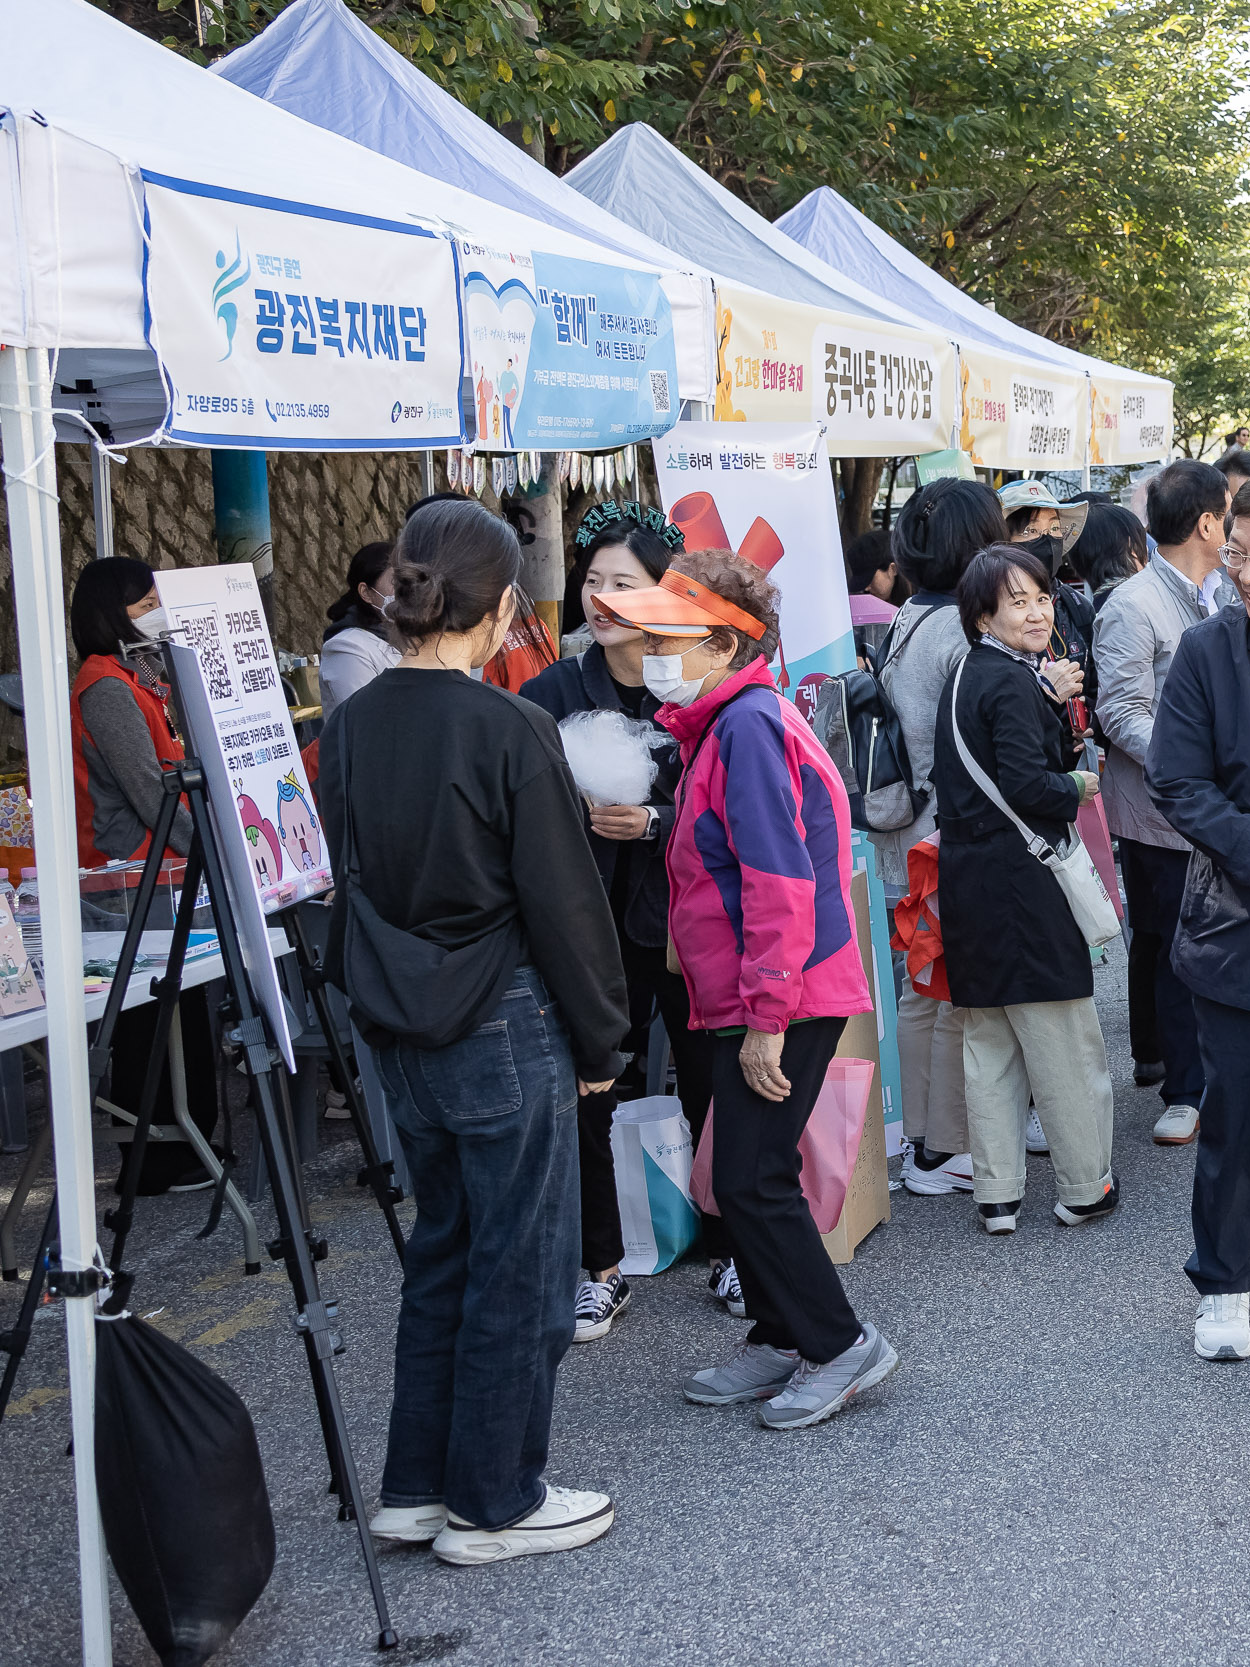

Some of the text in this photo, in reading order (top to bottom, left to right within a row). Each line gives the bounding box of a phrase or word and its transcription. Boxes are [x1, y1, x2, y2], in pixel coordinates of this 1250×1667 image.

[256, 254, 302, 280] 광진구 출연
[254, 288, 427, 362] 광진복지재단
[630, 317, 658, 337] 감사합니다
[613, 342, 646, 361] 든든합니다
[735, 355, 803, 392] 긴고랑 한마음 축제
[824, 343, 933, 420] 중곡4동 건강상담
[187, 394, 254, 415] 자양로95 5층
[275, 401, 330, 418] 02.2135.4959
[403, 406, 424, 419] 광진구
[666, 452, 818, 471] 소통하며 발전하는 행복광진
[225, 608, 263, 635] 카카오톡
[232, 638, 270, 665] 친구하고
[241, 666, 277, 694] 선물받자
[248, 724, 274, 744] 카카오톡
[272, 721, 286, 738] 채널
[227, 755, 243, 772] 추가
[241, 751, 256, 768] 하면
[255, 746, 274, 765] 선물이
